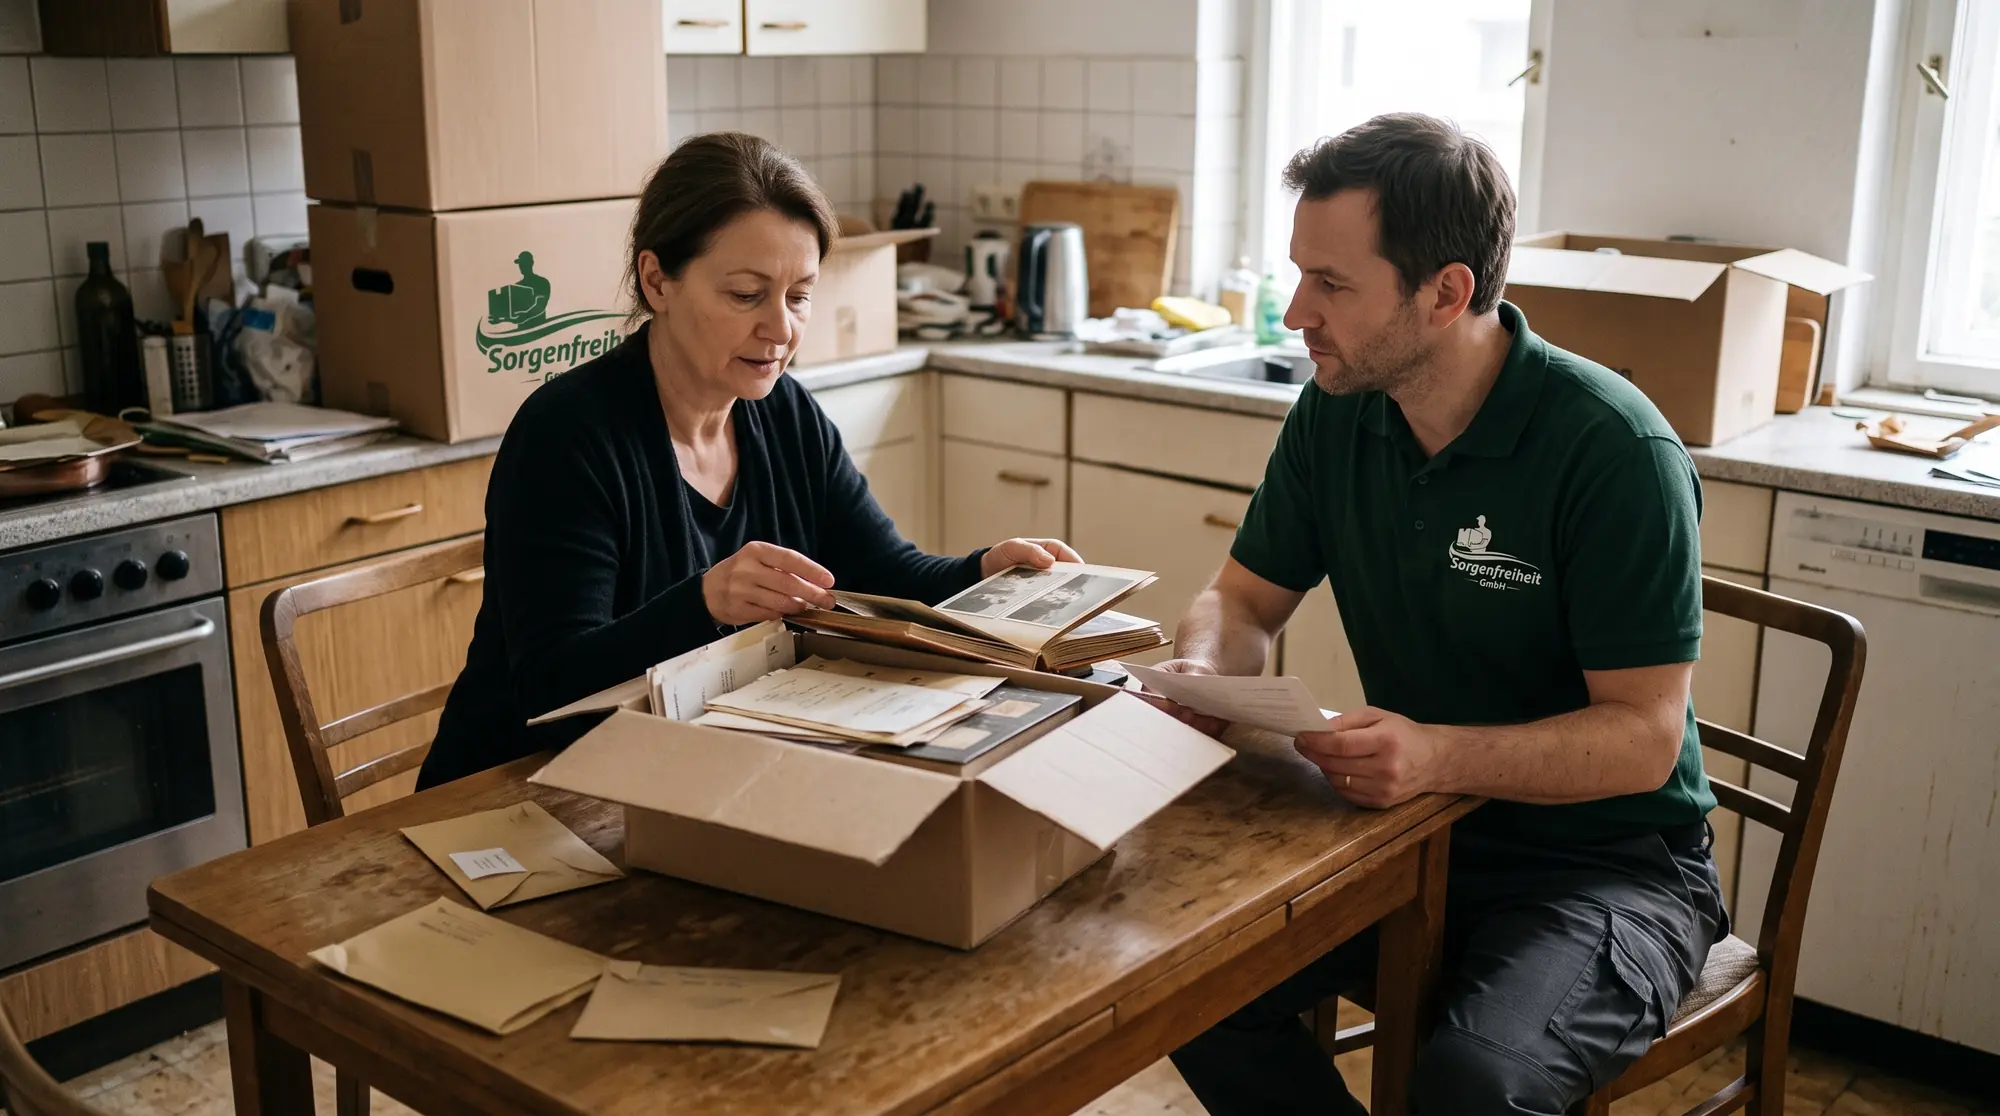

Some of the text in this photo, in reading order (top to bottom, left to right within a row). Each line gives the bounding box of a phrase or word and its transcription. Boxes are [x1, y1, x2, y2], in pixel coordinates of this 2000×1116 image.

[487, 329, 630, 373] Sorgenfreih
[1450, 557, 1542, 585] Sorgenfreiheit
[1479, 578, 1507, 591] GmbH
